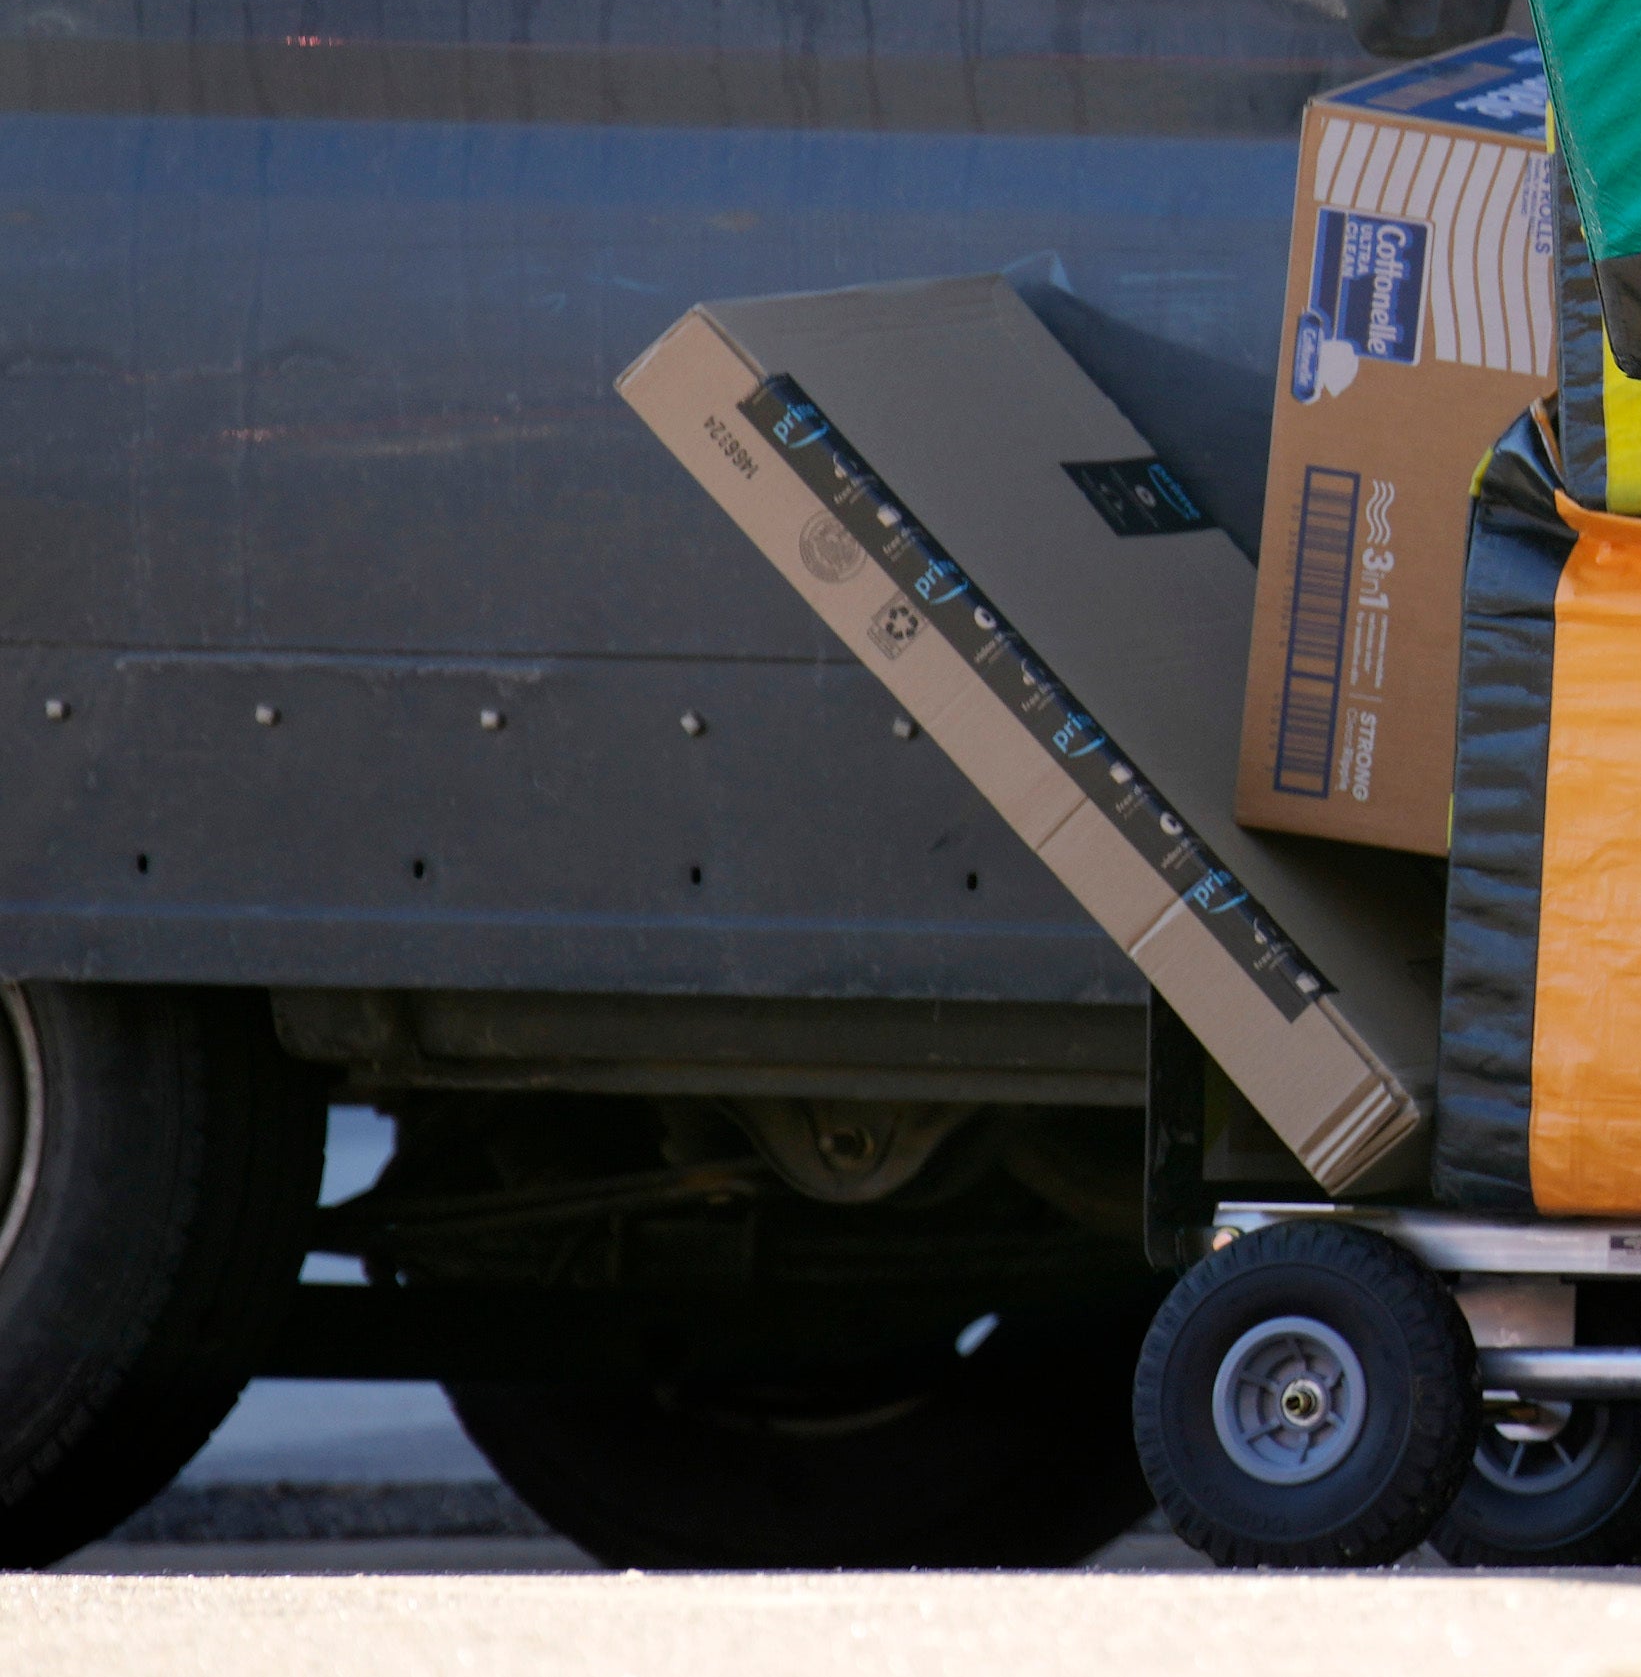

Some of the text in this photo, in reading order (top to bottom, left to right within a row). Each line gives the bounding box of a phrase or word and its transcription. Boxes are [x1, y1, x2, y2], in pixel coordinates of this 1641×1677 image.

[1341, 220, 1358, 278] CLEAN
[1357, 223, 1373, 275] ULTRA
[1366, 224, 1406, 356] Cottonelle
[1352, 711, 1377, 802] STRONG
